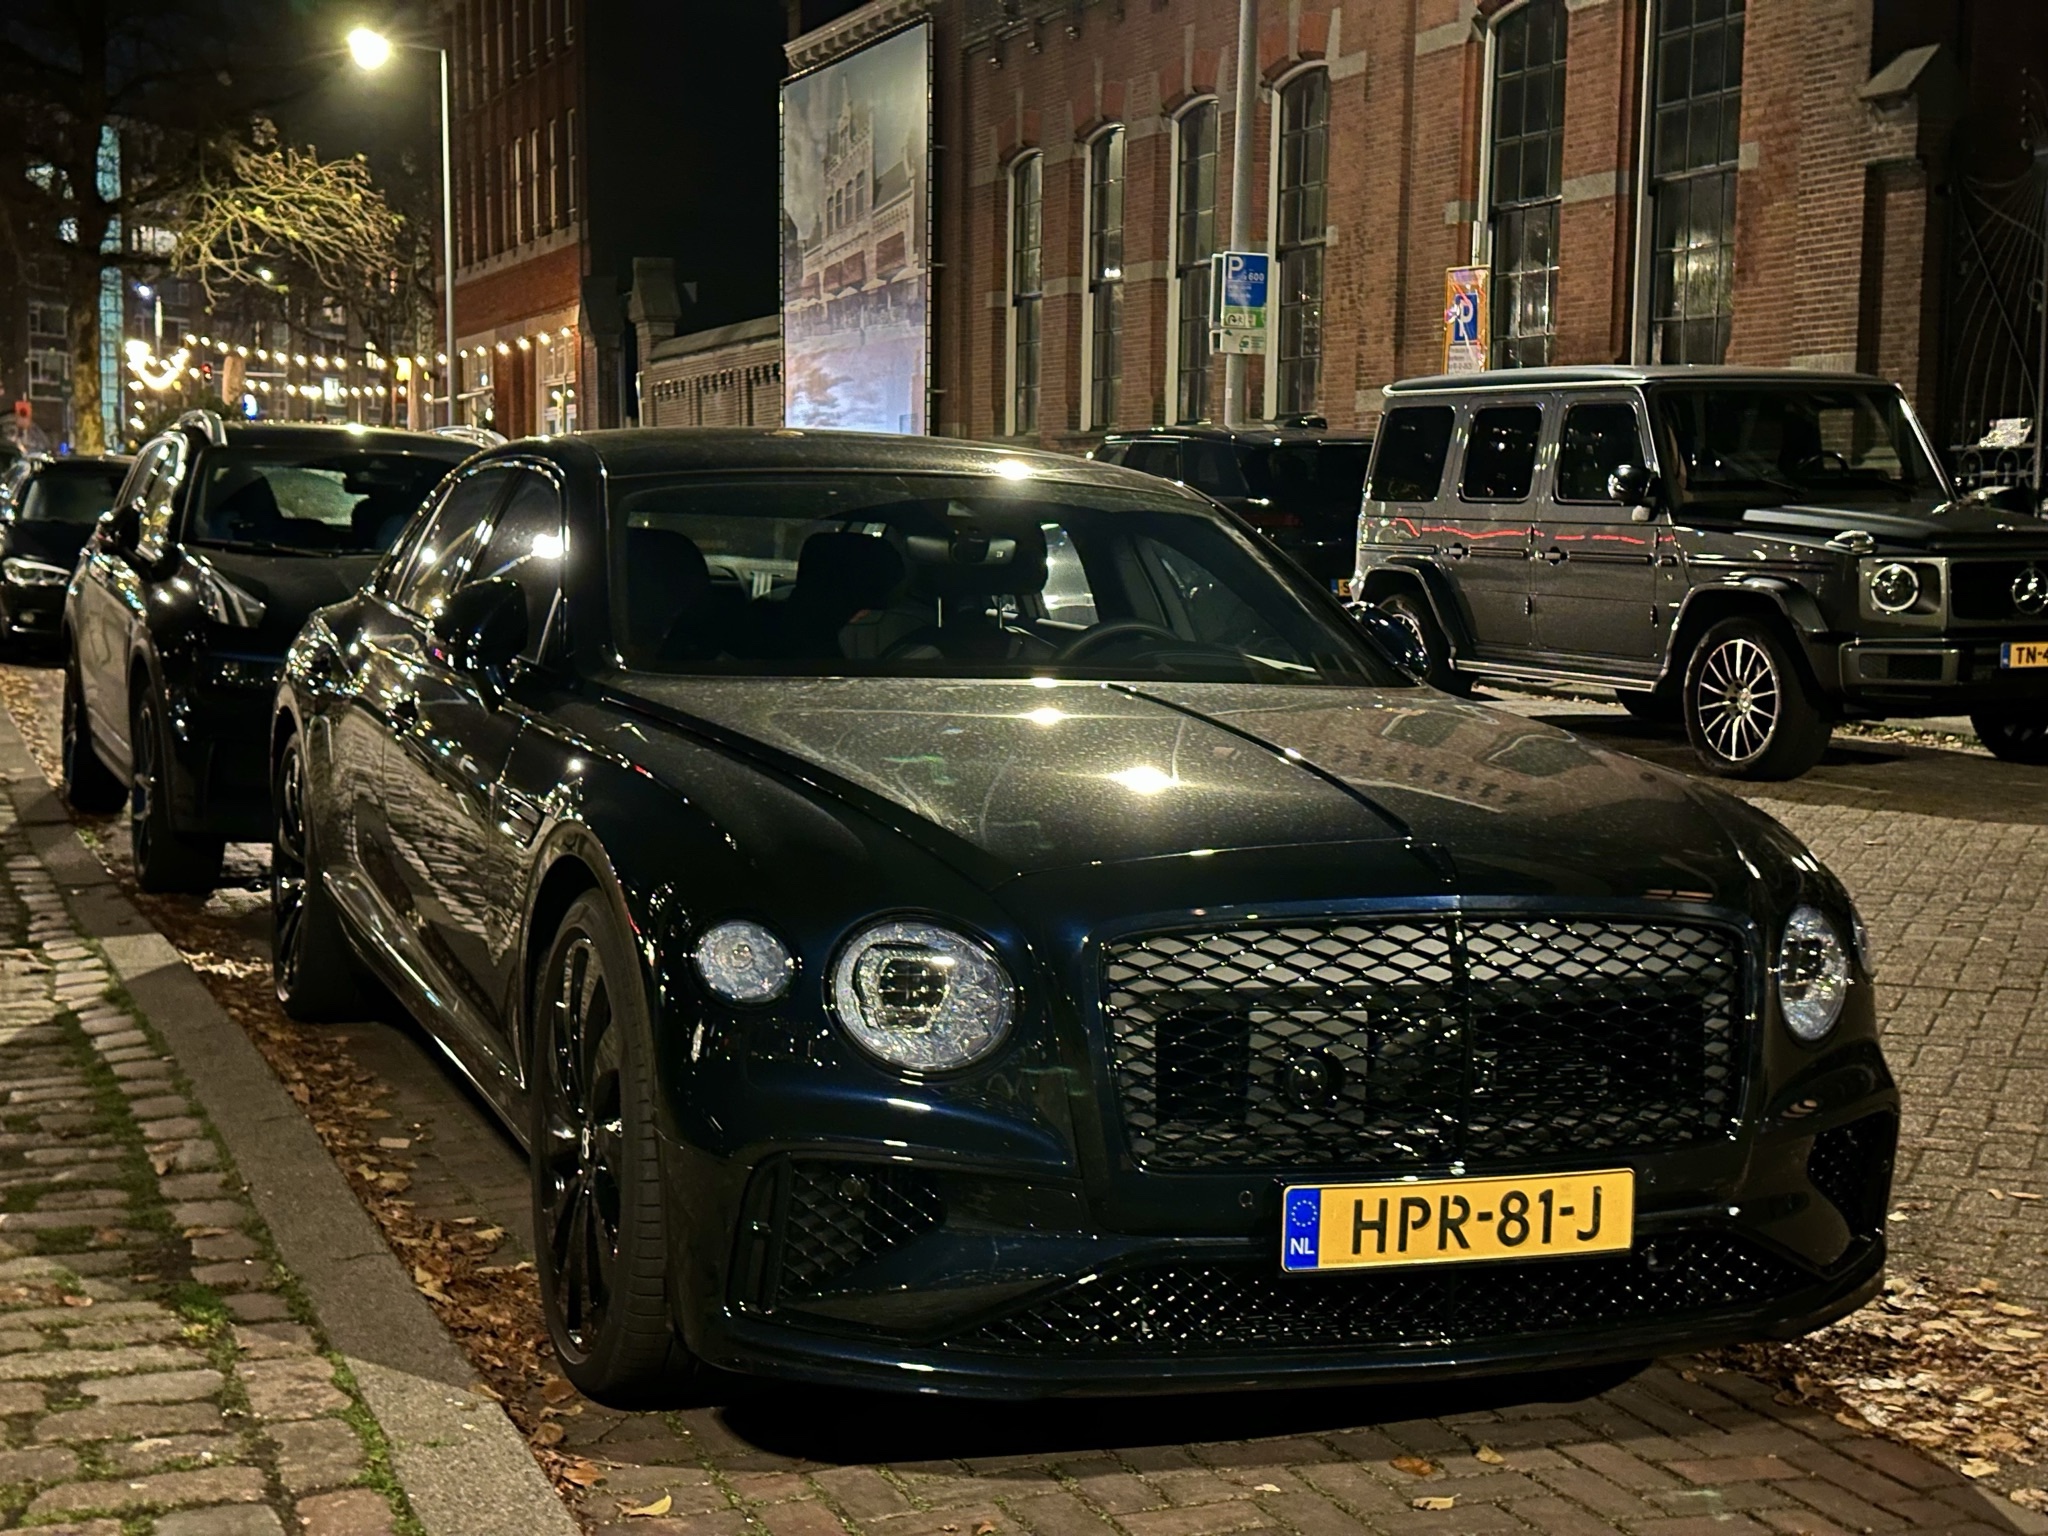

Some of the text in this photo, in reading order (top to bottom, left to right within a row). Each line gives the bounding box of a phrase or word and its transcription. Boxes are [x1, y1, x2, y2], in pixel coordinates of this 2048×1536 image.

[1228, 256, 1244, 279] P
[1459, 297, 1474, 337] P
[1290, 1185, 1602, 1255] NL HPR-81-J
